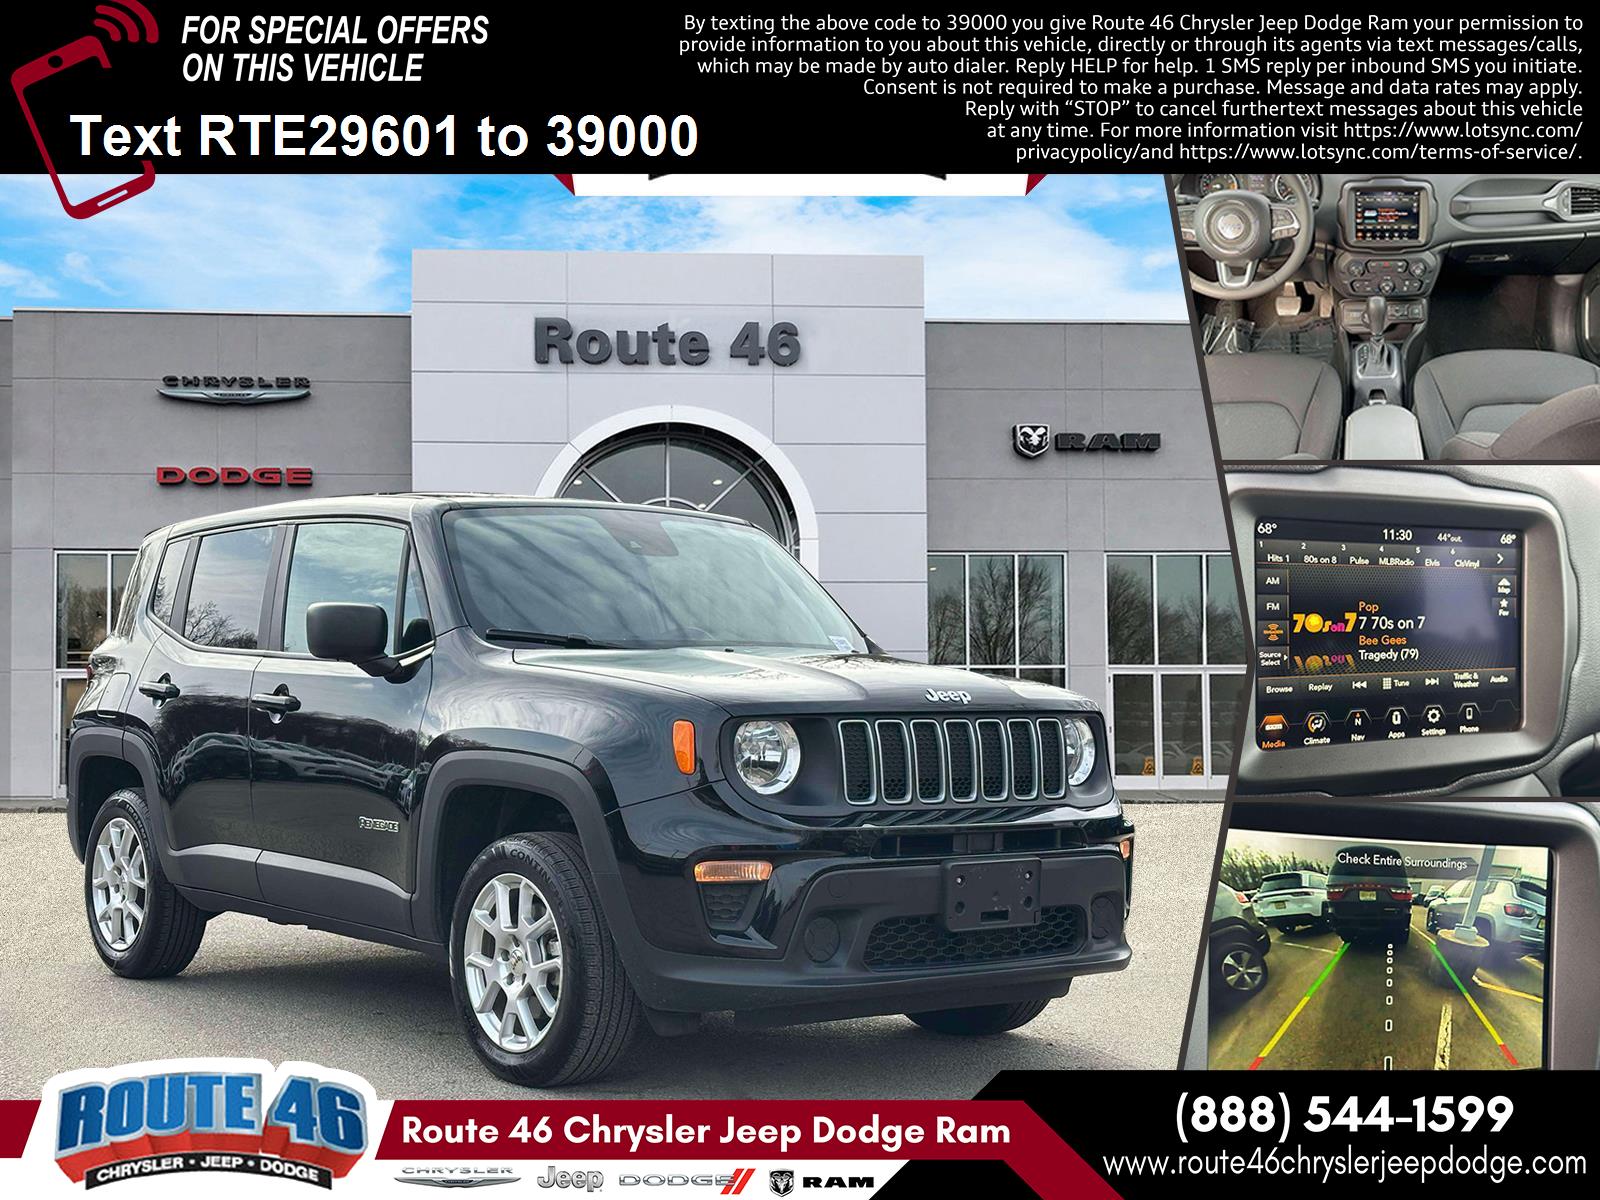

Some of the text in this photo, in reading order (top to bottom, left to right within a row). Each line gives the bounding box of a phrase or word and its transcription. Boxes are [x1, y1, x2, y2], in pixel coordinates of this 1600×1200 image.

[534, 317, 801, 367] Route 46
[162, 375, 311, 388] CHRYSLER
[1054, 433, 1161, 452] RAM
[156, 466, 313, 486] DODGE
[1257, 523, 1278, 534] 68°
[1382, 528, 1413, 541] 11:30
[1500, 533, 1517, 545] 68°
[1301, 542, 1306, 550] 2
[1379, 545, 1384, 553] 4
[1267, 553, 1290, 563] Hits 1
[1303, 555, 1318, 564] 80s
[1331, 555, 1337, 564] 8
[1349, 556, 1370, 565] Pulse
[1379, 557, 1415, 566] MLBRadio
[1424, 558, 1441, 567] Elvis
[1265, 577, 1280, 585] AM
[1266, 602, 1280, 611] FM
[1358, 601, 1379, 614] Pop
[1358, 615, 1426, 630] 7 70s on 7
[1359, 635, 1407, 646] Bee Gees
[1259, 651, 1281, 659] Source
[1358, 648, 1419, 662] Tragedy (79)
[1260, 659, 1281, 667] Select
[1393, 679, 1410, 687] Tune
[1490, 675, 1509, 683] Audio
[1266, 686, 1293, 694] Browse
[1308, 683, 1333, 692] Replay
[925, 688, 972, 705] Jeep
[1421, 728, 1447, 737] Settings
[1459, 725, 1480, 734] Phone
[1350, 734, 1366, 742] Nav
[1388, 731, 1406, 739] Apps
[1262, 740, 1286, 749] Media
[1303, 737, 1331, 745] Climate
[359, 816, 399, 833] RENEGADE
[1337, 852, 1468, 871] Check Entire Surroundings
